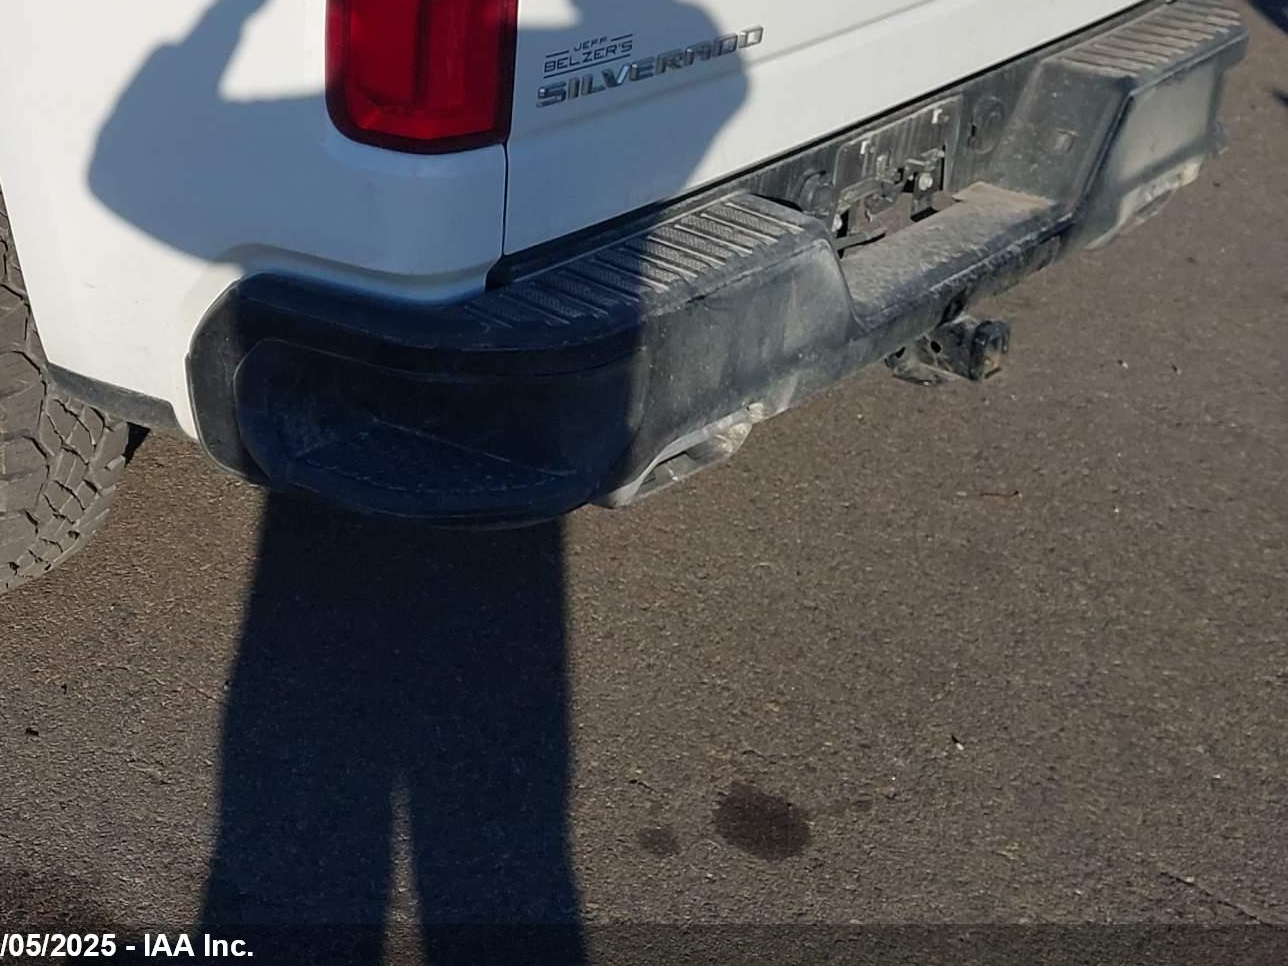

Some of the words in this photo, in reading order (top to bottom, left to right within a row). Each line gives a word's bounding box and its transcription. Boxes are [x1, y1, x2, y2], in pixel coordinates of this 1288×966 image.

[544, 39, 633, 73] BELZER'S
[574, 36, 608, 52] JEFF
[536, 26, 764, 108] SILVERADO
